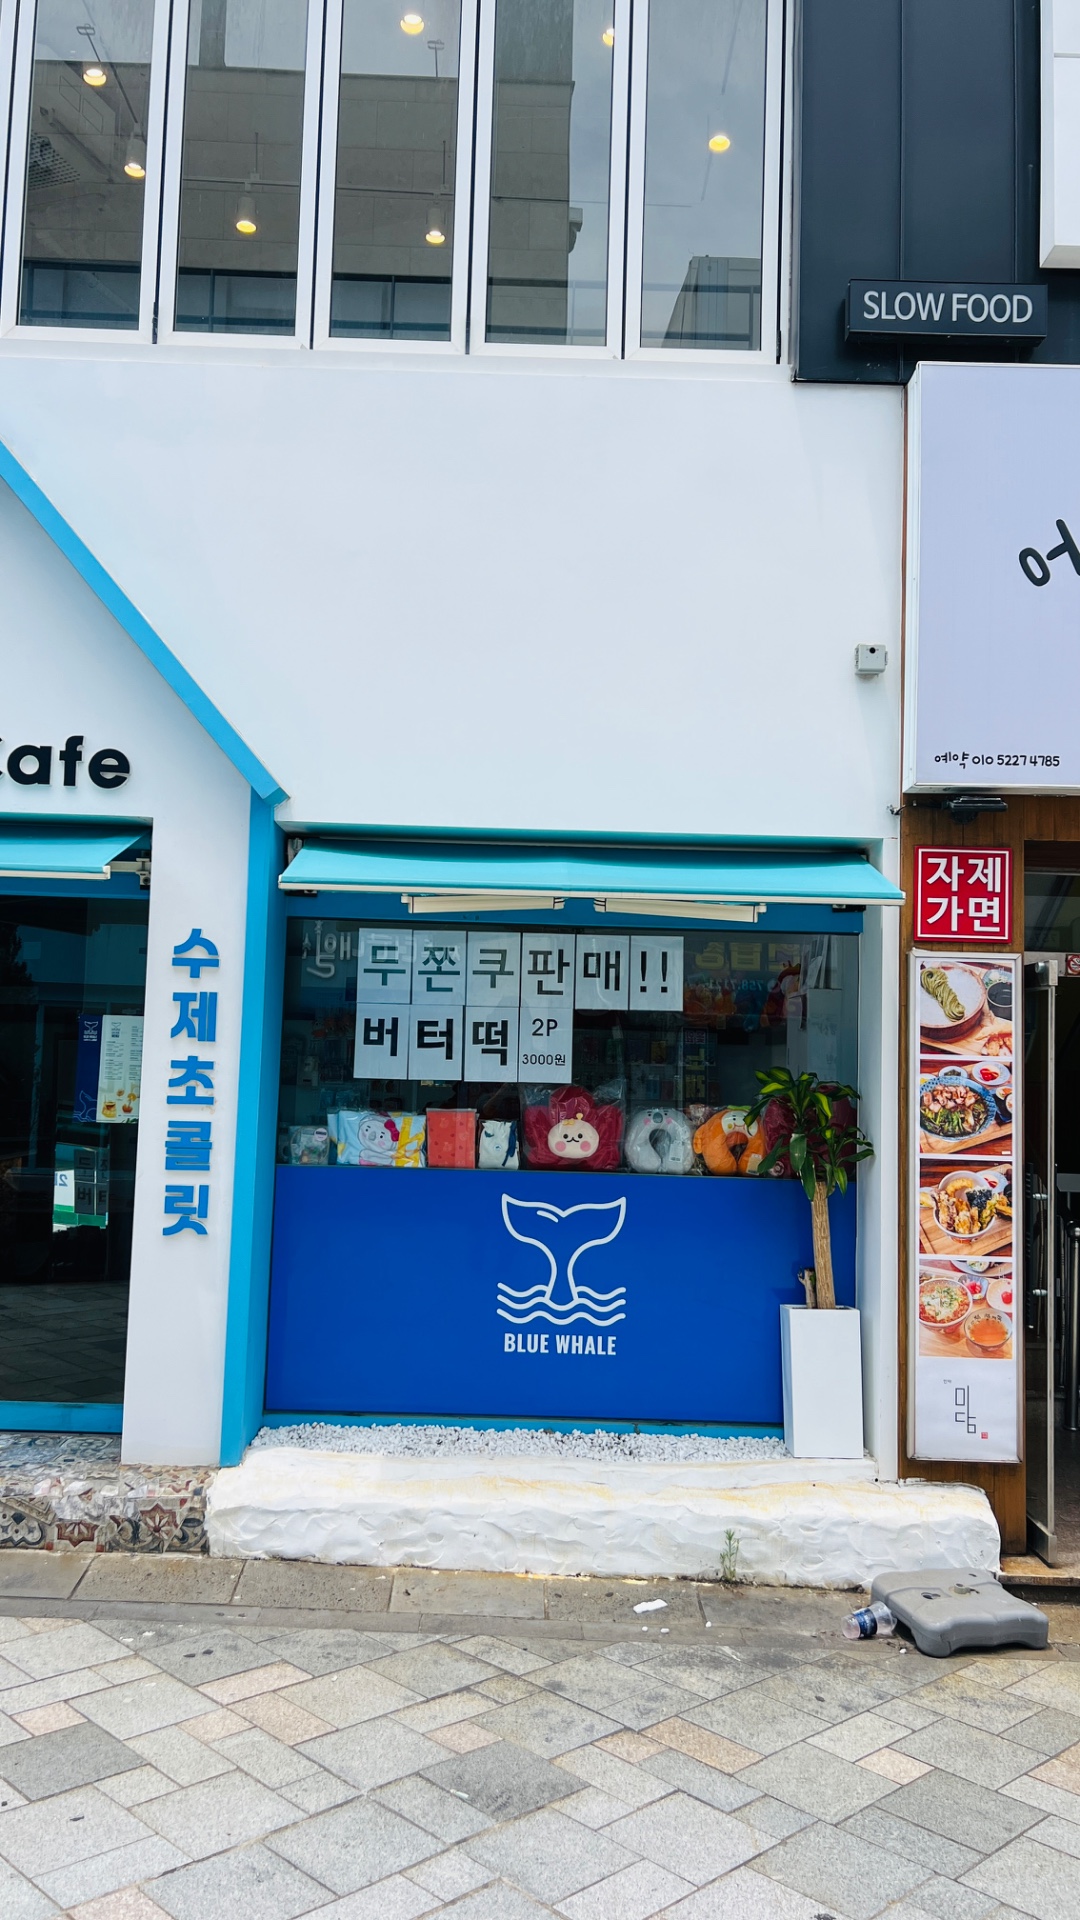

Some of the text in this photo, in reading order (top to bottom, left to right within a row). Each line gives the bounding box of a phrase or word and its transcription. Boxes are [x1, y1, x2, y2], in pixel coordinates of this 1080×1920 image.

[863, 290, 1033, 323] SLOW FOOD
[0, 735, 130, 789] afe
[934, 751, 970, 769] 예약
[531, 1018, 558, 1037] 2P
[363, 1016, 508, 1066] 버터떡
[522, 1053, 566, 1066] 3000원
[504, 1333, 617, 1356] BLUE WHALE
